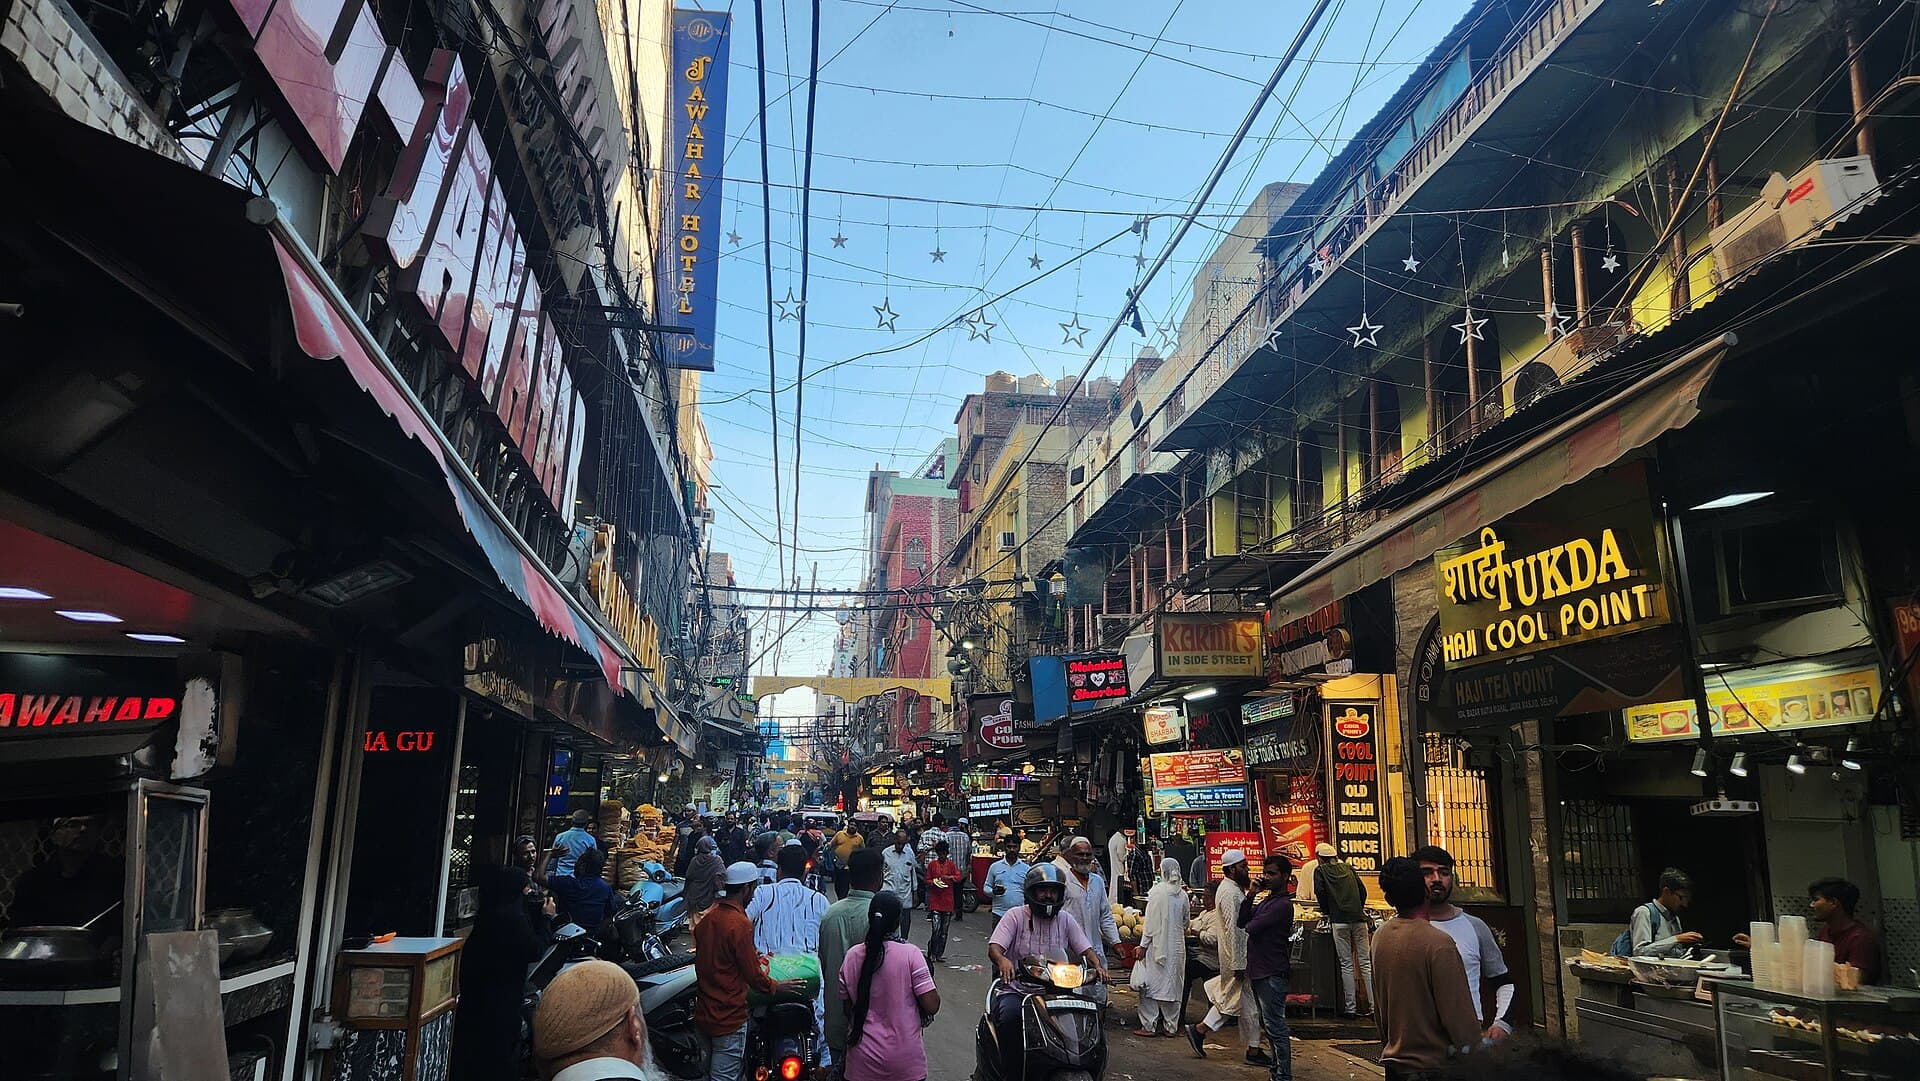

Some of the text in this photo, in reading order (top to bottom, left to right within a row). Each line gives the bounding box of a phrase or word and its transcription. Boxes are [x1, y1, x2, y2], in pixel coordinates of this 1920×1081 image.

[679, 56, 711, 313] JAWAHAR HOTEL
[1440, 526, 1630, 611] शाही TUKDA
[1443, 584, 1649, 662] HAJI COOL POINT
[1069, 659, 1124, 674] Mohabbat
[1168, 655, 1253, 665] IN SIDE STREET
[1073, 686, 1127, 701] Sharbat
[1455, 667, 1554, 706] HAJI TEA POINT
[1151, 727, 1176, 737] SHARBAT
[396, 732, 434, 751] GU
[1338, 742, 1373, 760] COOL
[1335, 763, 1376, 783] POINT
[1345, 784, 1368, 798] OLD
[1341, 803, 1374, 816] DELHI
[1339, 821, 1379, 835] FAMOUS
[1341, 839, 1379, 853] SINCE
